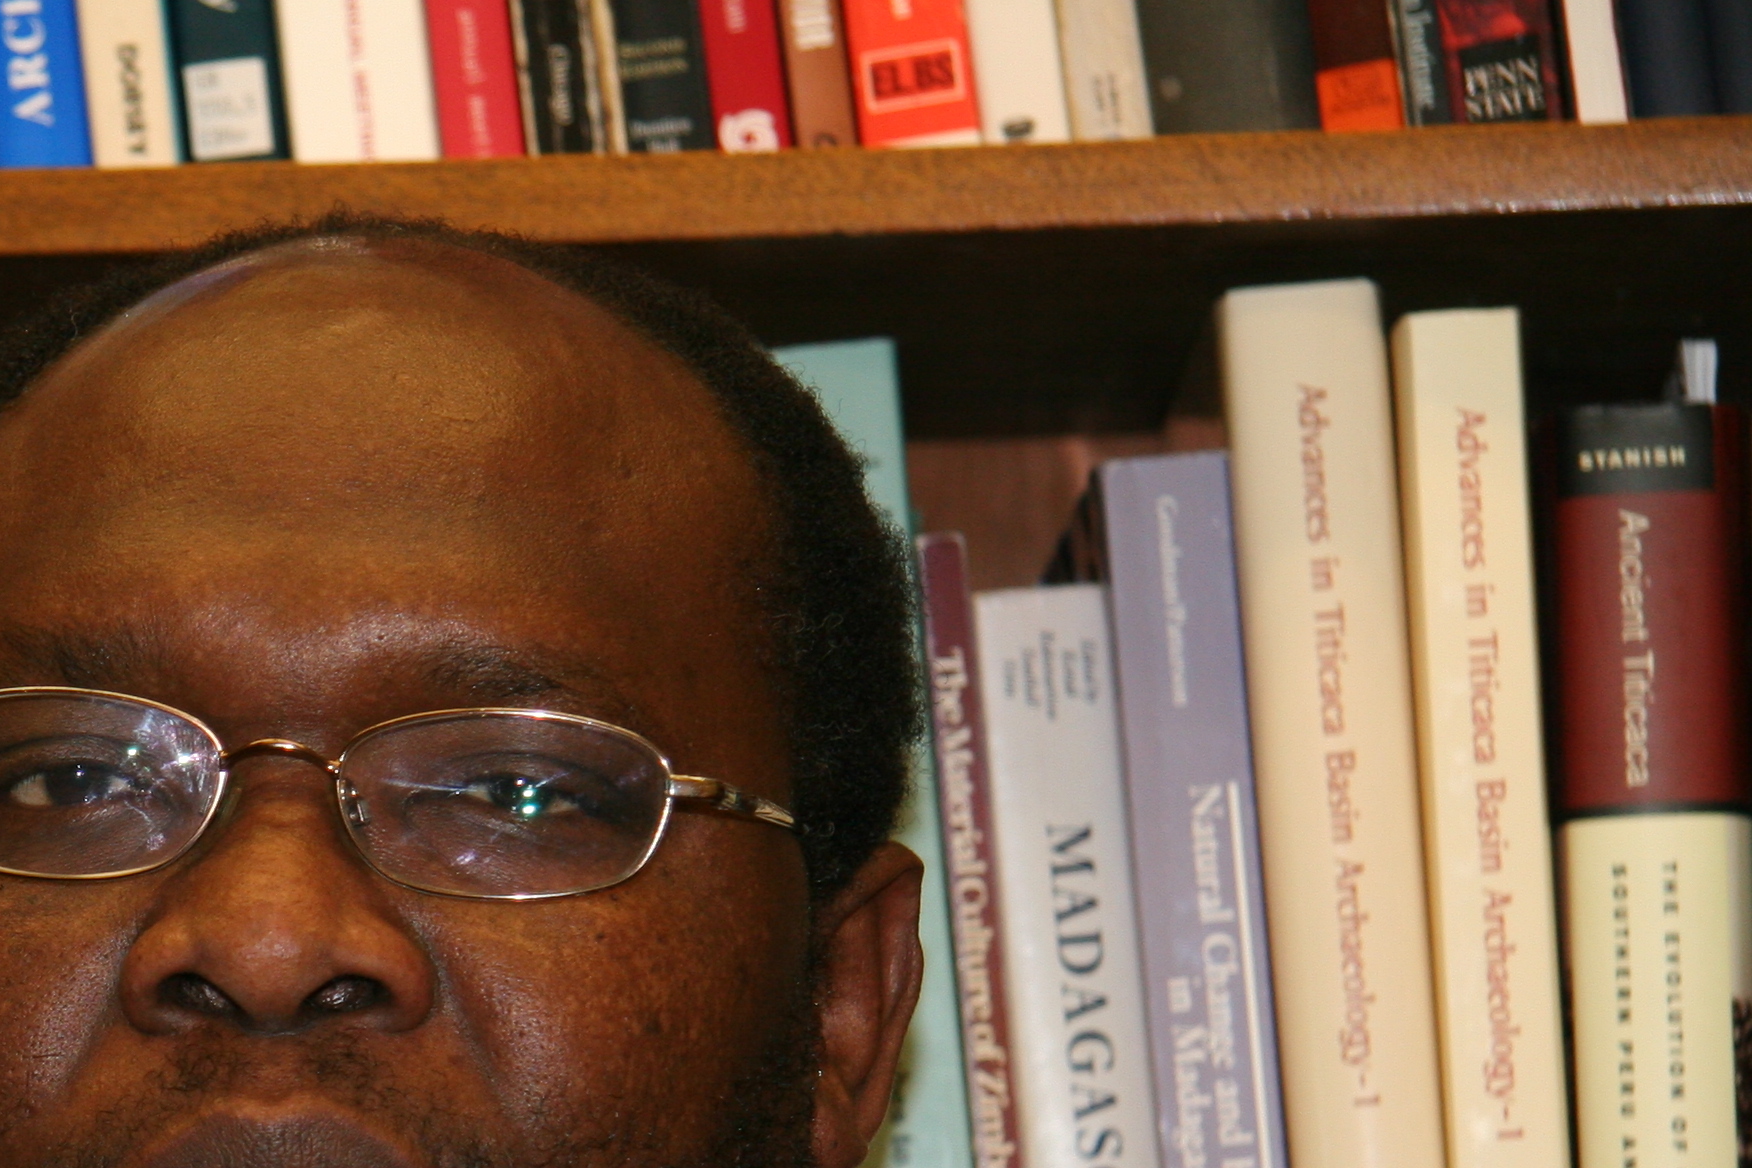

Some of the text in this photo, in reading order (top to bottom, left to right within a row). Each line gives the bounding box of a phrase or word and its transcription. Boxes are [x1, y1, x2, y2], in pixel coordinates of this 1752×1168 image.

[117, 43, 144, 156] DORSEY
[870, 50, 955, 102] ELBS
[1464, 57, 1538, 96] PENN
[1465, 87, 1545, 123] STATE
[1295, 382, 1332, 544] Advances
[1454, 407, 1491, 568] Advances
[1577, 444, 1687, 474] STANISH
[1309, 557, 1342, 592] in
[1464, 584, 1497, 618] in
[931, 646, 967, 727] The
[1313, 603, 1350, 737] Titicaca
[1616, 508, 1656, 788] Ancient Titicaca
[1467, 631, 1501, 764] Titicaca
[935, 726, 985, 874] Material
[1324, 749, 1360, 844] Basin
[1473, 778, 1510, 874] Basin
[1189, 782, 1236, 924] Natural
[1661, 860, 1680, 918] THE
[956, 877, 994, 1019] Culture
[1610, 863, 1632, 1025] SOUTHERN
[1165, 976, 1201, 1014] in
[1203, 932, 1239, 1069] Change
[1662, 931, 1687, 1101] EVOLUTION
[971, 1023, 1004, 1067] of
[1617, 1041, 1636, 1120] PERU
[1214, 1078, 1252, 1148] and
[1669, 1117, 1689, 1156] OF
